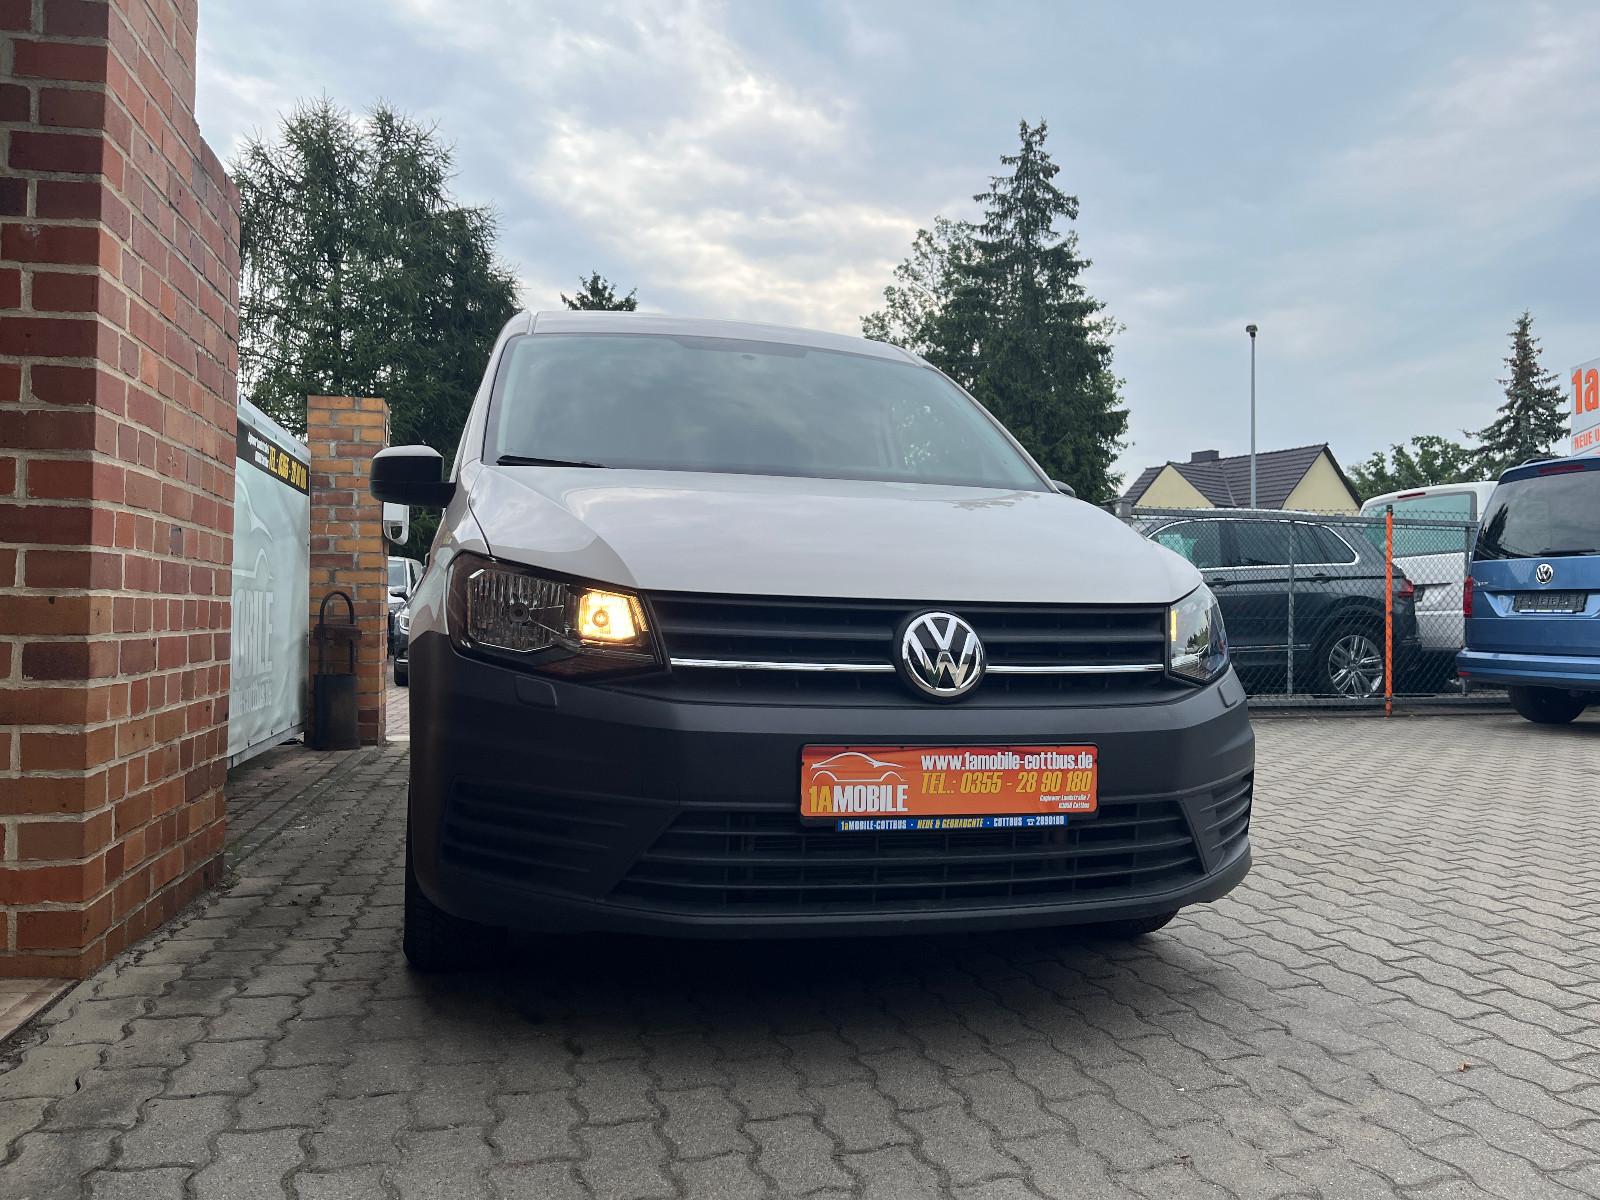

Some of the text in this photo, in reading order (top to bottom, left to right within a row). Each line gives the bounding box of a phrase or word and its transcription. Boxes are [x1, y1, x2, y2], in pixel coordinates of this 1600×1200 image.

[1574, 431, 1592, 449] NEUE
[921, 752, 1093, 770] www.1amobile-cottbus.de
[960, 772, 1003, 794] 0355
[1016, 772, 1038, 793] 28
[1040, 772, 1063, 793] 90
[1066, 771, 1093, 793] 180
[993, 817, 1023, 827] COTTBUS
[1036, 816, 1065, 826] 2890180
